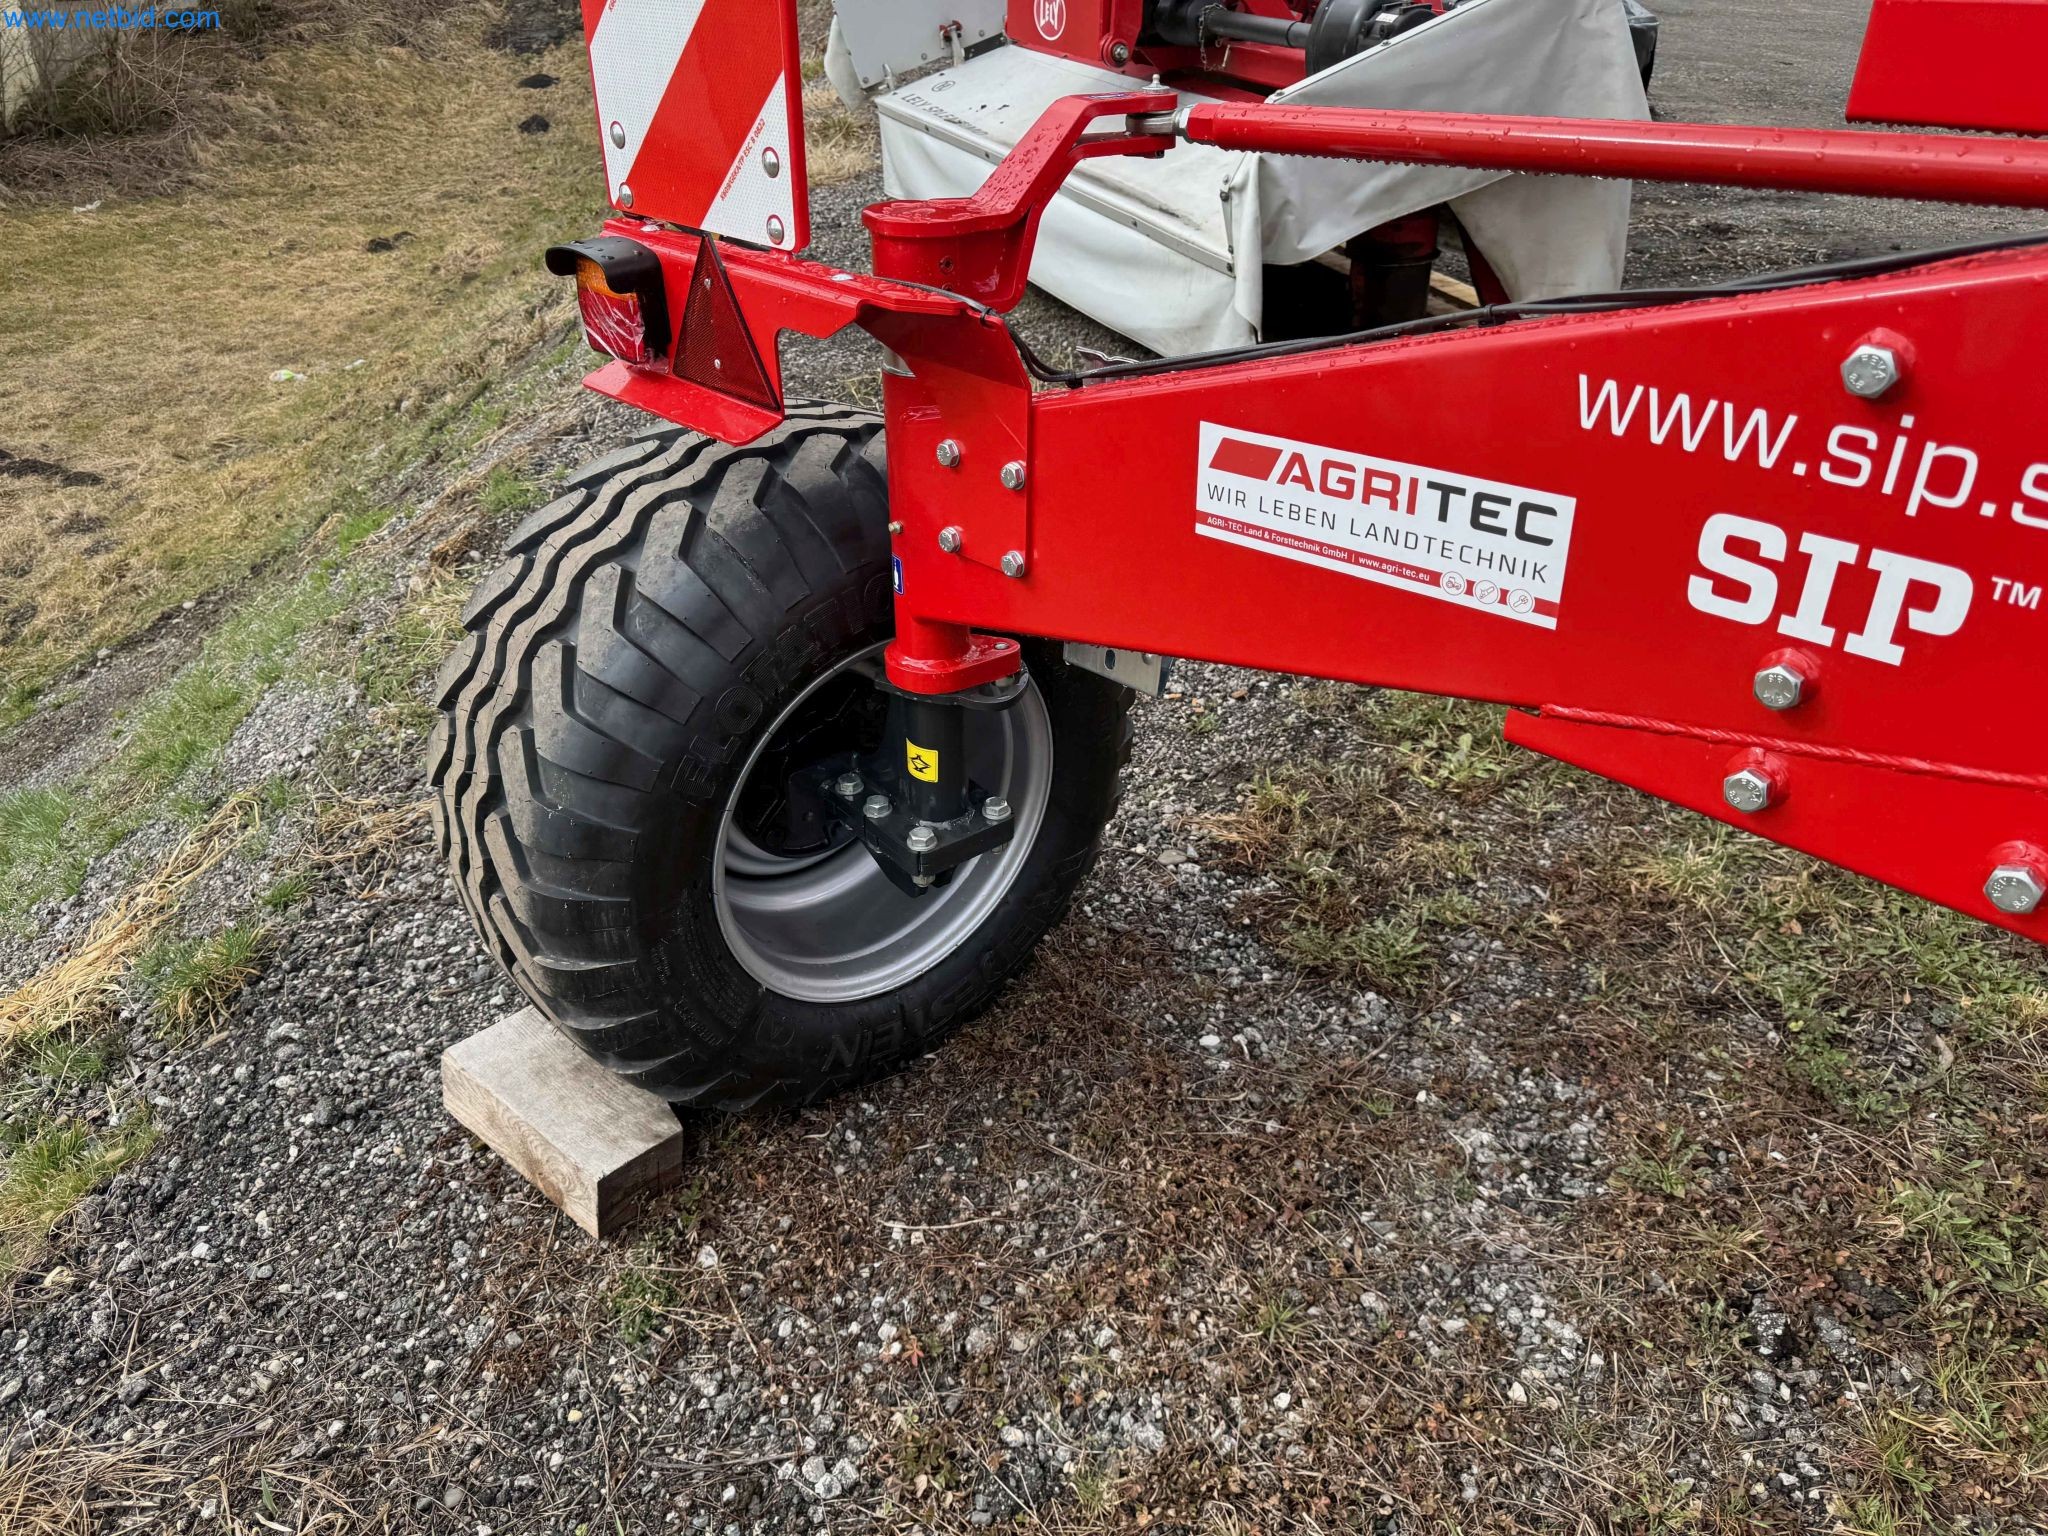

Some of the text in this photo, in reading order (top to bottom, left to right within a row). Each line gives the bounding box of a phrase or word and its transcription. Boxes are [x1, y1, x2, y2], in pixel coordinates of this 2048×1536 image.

[1039, 0, 1060, 30] LELY
[1207, 482, 1549, 584] WIR LEBEN LANDTECHNIK
[1276, 451, 1559, 547] AGRITEC
[1207, 516, 1242, 532] AGRI-TEC
[1243, 525, 1263, 538] Land
[1271, 532, 1321, 553] Forsttechnik
[1322, 545, 1348, 561] GmbH
[1358, 555, 1431, 582] www.agri-tec.eu
[1688, 512, 1974, 666] SIP
